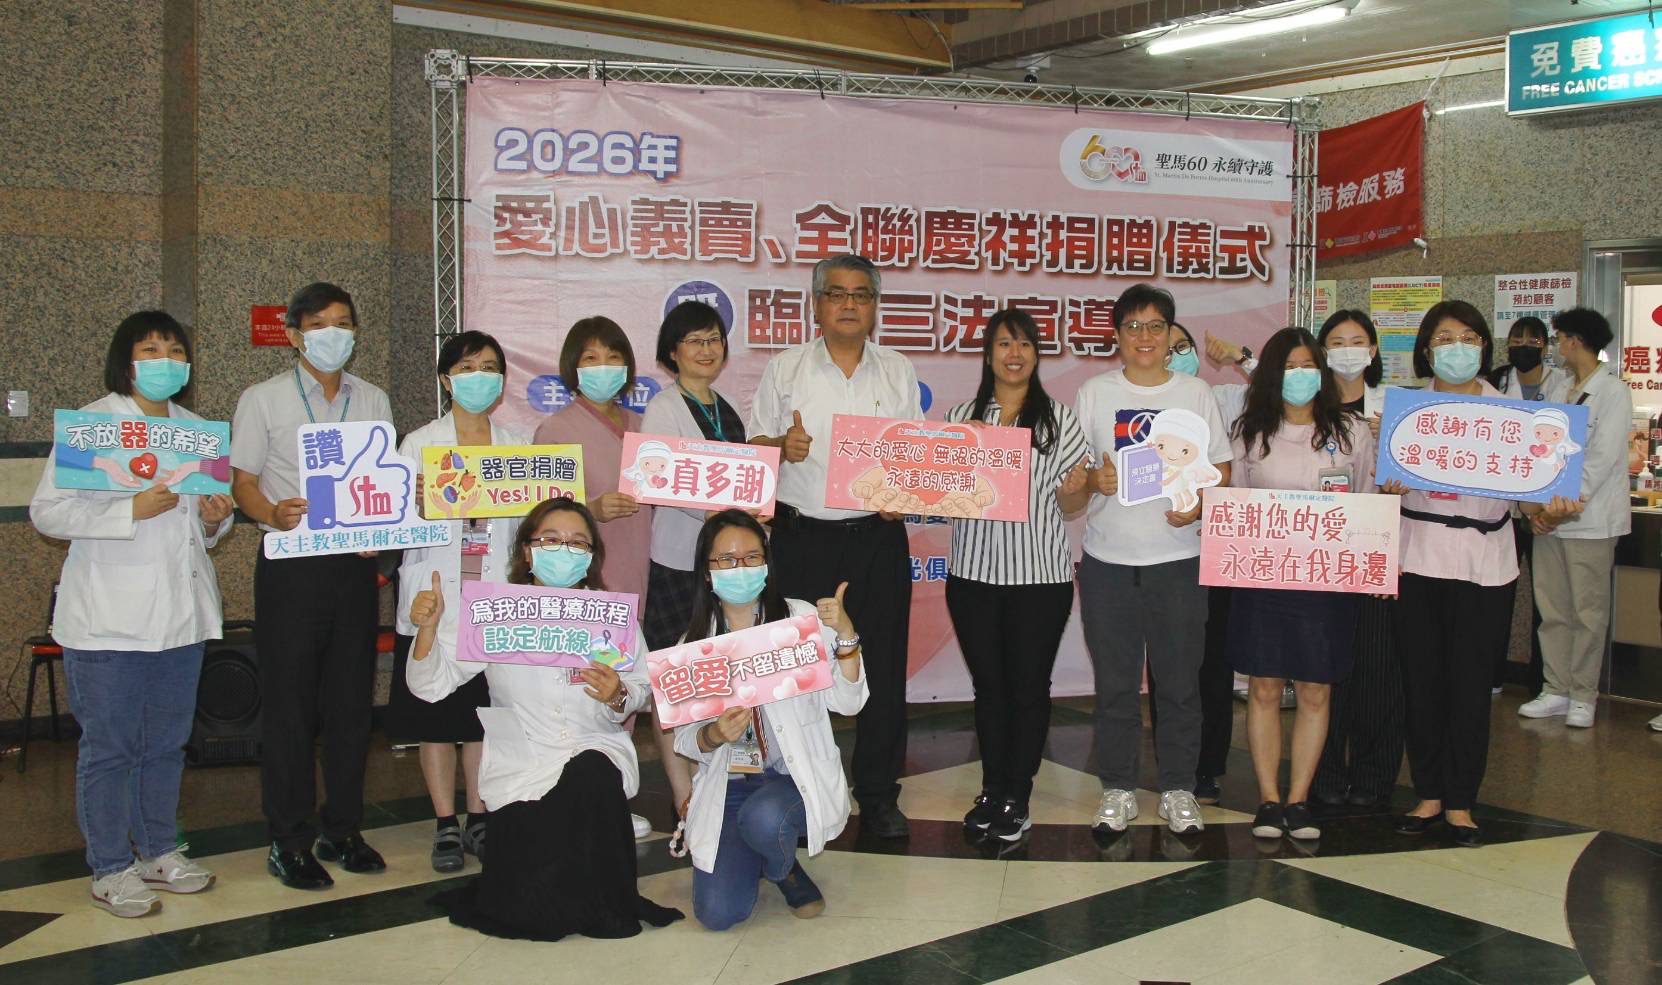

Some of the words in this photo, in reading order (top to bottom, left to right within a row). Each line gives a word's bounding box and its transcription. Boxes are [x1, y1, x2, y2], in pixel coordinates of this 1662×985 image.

[1522, 82, 1560, 100] FREE
[1564, 73, 1630, 95] CANCER
[495, 127, 680, 181] 2026年
[1155, 152, 1208, 172] 聖馬60
[1211, 155, 1274, 177] 永續守護
[493, 191, 1271, 281] 愛心義賣、全聯慶祥捐贈儀式
[1498, 278, 1572, 291] 整合性健康篩檢
[1513, 293, 1554, 305] 預約顧客
[744, 288, 1118, 357] 臨三法宣導
[67, 421, 221, 459] 不放器的希望
[1416, 411, 1522, 444] 感謝有您
[302, 428, 346, 470] 讚
[837, 437, 928, 463] 大大的愛心
[933, 444, 1023, 470] 無限的溫暖
[1399, 444, 1534, 478] 溫暖的支持
[481, 456, 577, 480] 器官捐贈
[671, 457, 766, 504] 真多謝
[886, 466, 977, 493] 永遠的感謝
[486, 485, 530, 505] Yes!
[536, 485, 542, 502] I
[548, 485, 576, 502] Do
[1208, 501, 1347, 543] 感謝您的愛
[270, 524, 449, 554] 天主教聖馬爾定醫院
[1220, 544, 1388, 587] 永遠在我身邊
[484, 625, 592, 655] 設定航線
